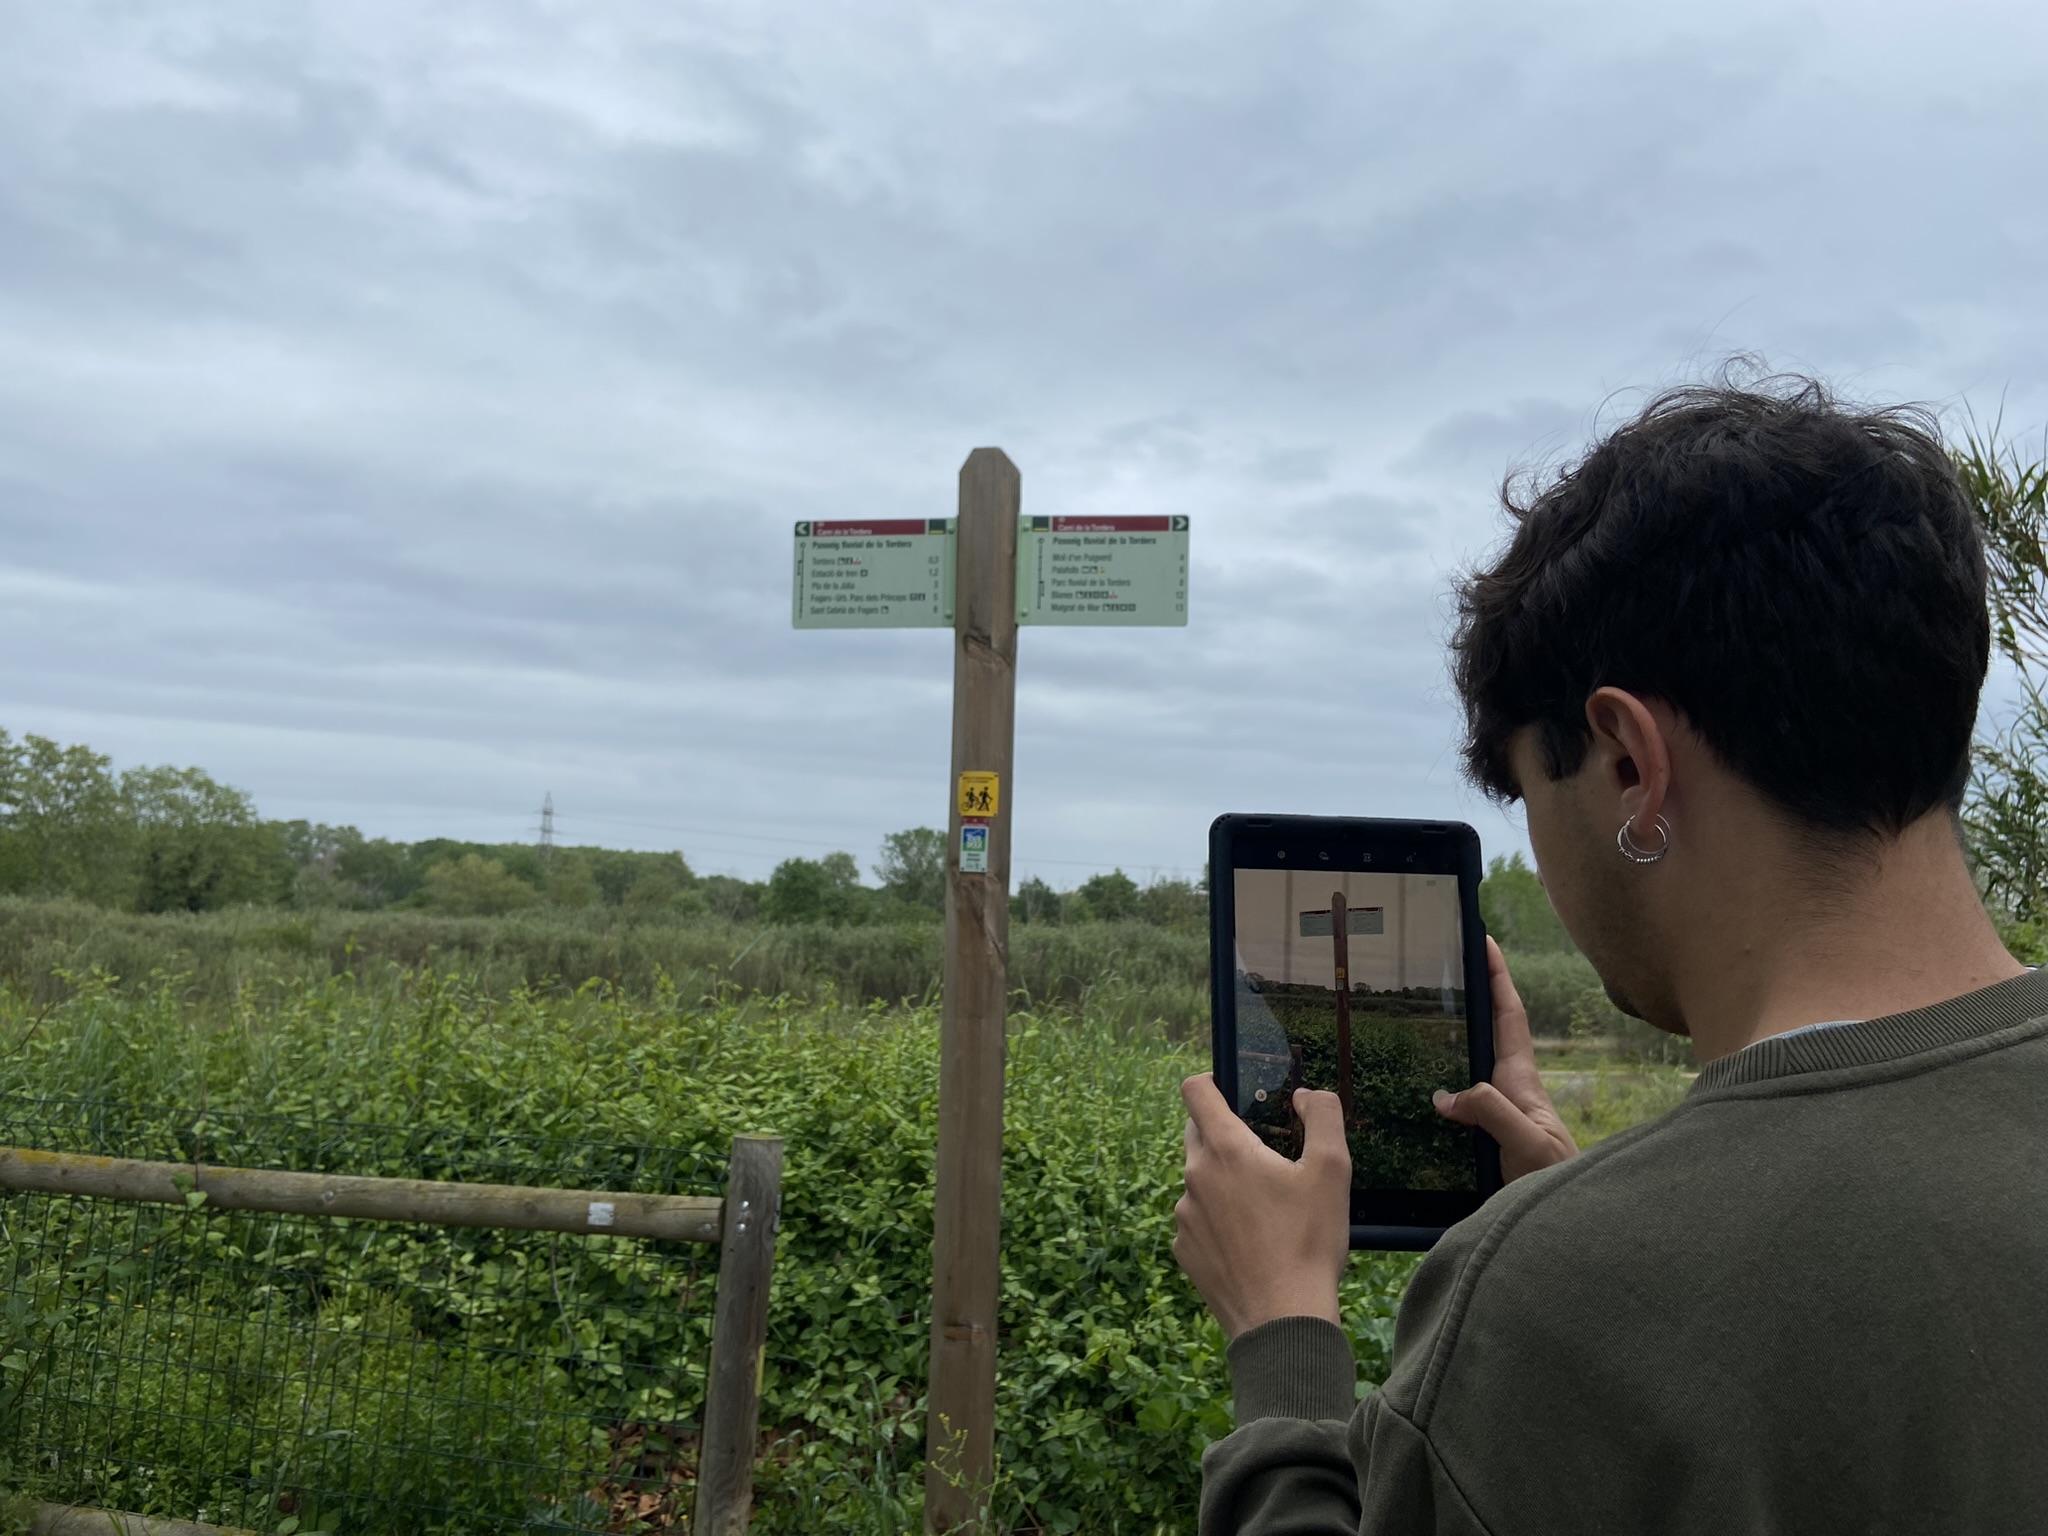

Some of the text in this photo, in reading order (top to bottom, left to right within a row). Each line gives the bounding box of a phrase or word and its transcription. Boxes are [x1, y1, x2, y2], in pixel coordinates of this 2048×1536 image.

[812, 542, 840, 550] Passeig
[886, 540, 912, 548] Tordera
[1053, 537, 1080, 546] Passeig
[823, 582, 831, 590] de
[832, 582, 838, 590] la
[848, 606, 856, 614] de
